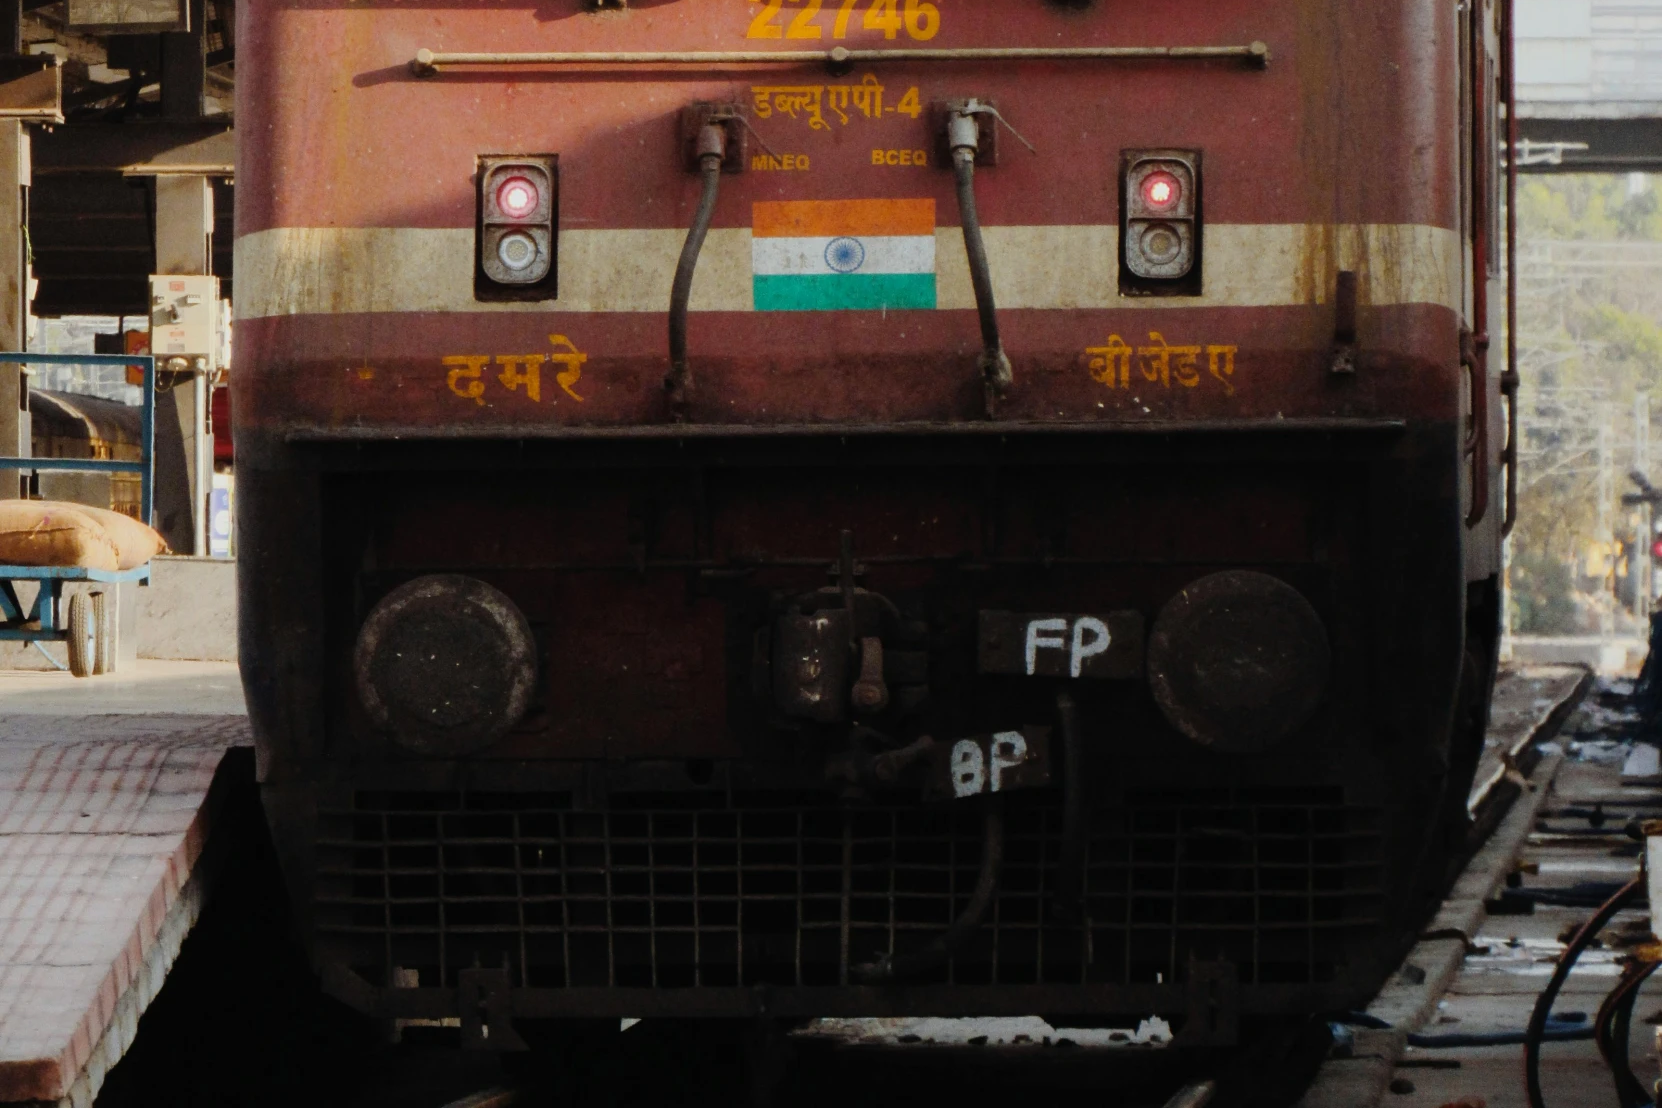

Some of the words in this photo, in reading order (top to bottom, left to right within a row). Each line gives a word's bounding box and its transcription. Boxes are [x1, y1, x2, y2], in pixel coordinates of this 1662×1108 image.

[871, 149, 927, 166] BCEQ
[1025, 616, 1111, 678] FP
[951, 731, 1027, 798] BP
